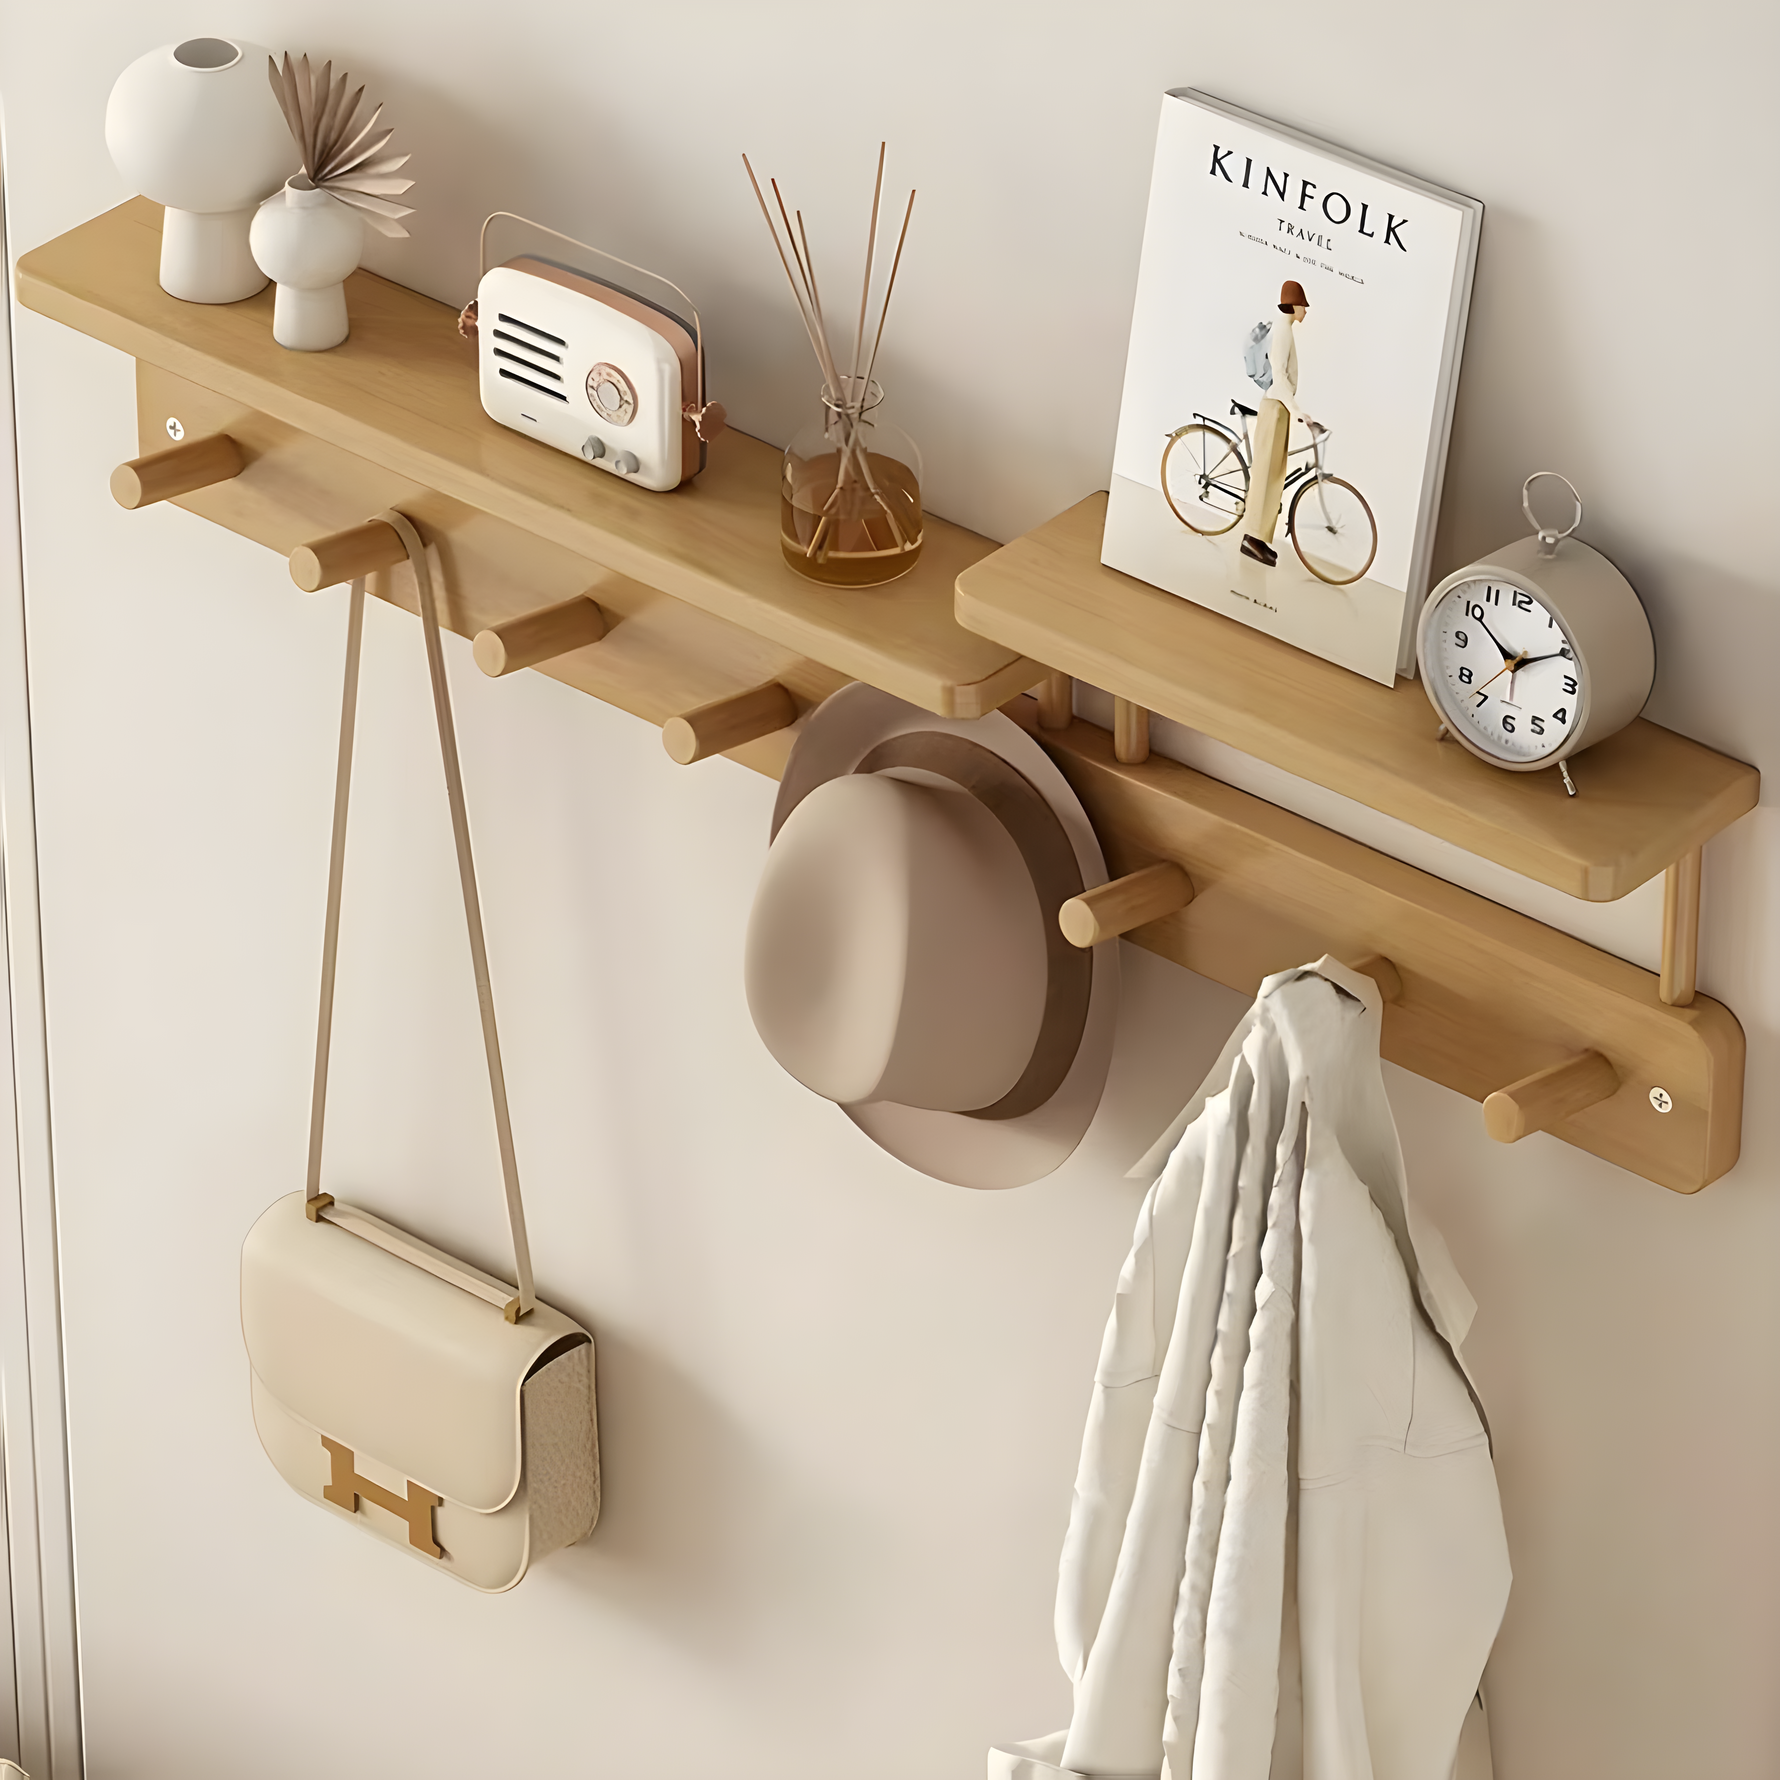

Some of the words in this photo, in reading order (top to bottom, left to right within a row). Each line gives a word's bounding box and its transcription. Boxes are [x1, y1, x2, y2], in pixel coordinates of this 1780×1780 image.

[1209, 143, 1409, 252] KINFOLK
[1486, 585, 1500, 606] 11
[1512, 590, 1534, 613] 12
[1465, 600, 1485, 622] 10
[1548, 616, 1554, 629] 1
[1455, 631, 1468, 649] 9
[1458, 667, 1474, 685] 8
[1562, 675, 1578, 696] 3
[1475, 691, 1489, 708] 7
[1502, 715, 1516, 734] 6
[1531, 715, 1545, 735] 5
[1552, 708, 1567, 725] 4
[321, 1434, 444, 1560] H
